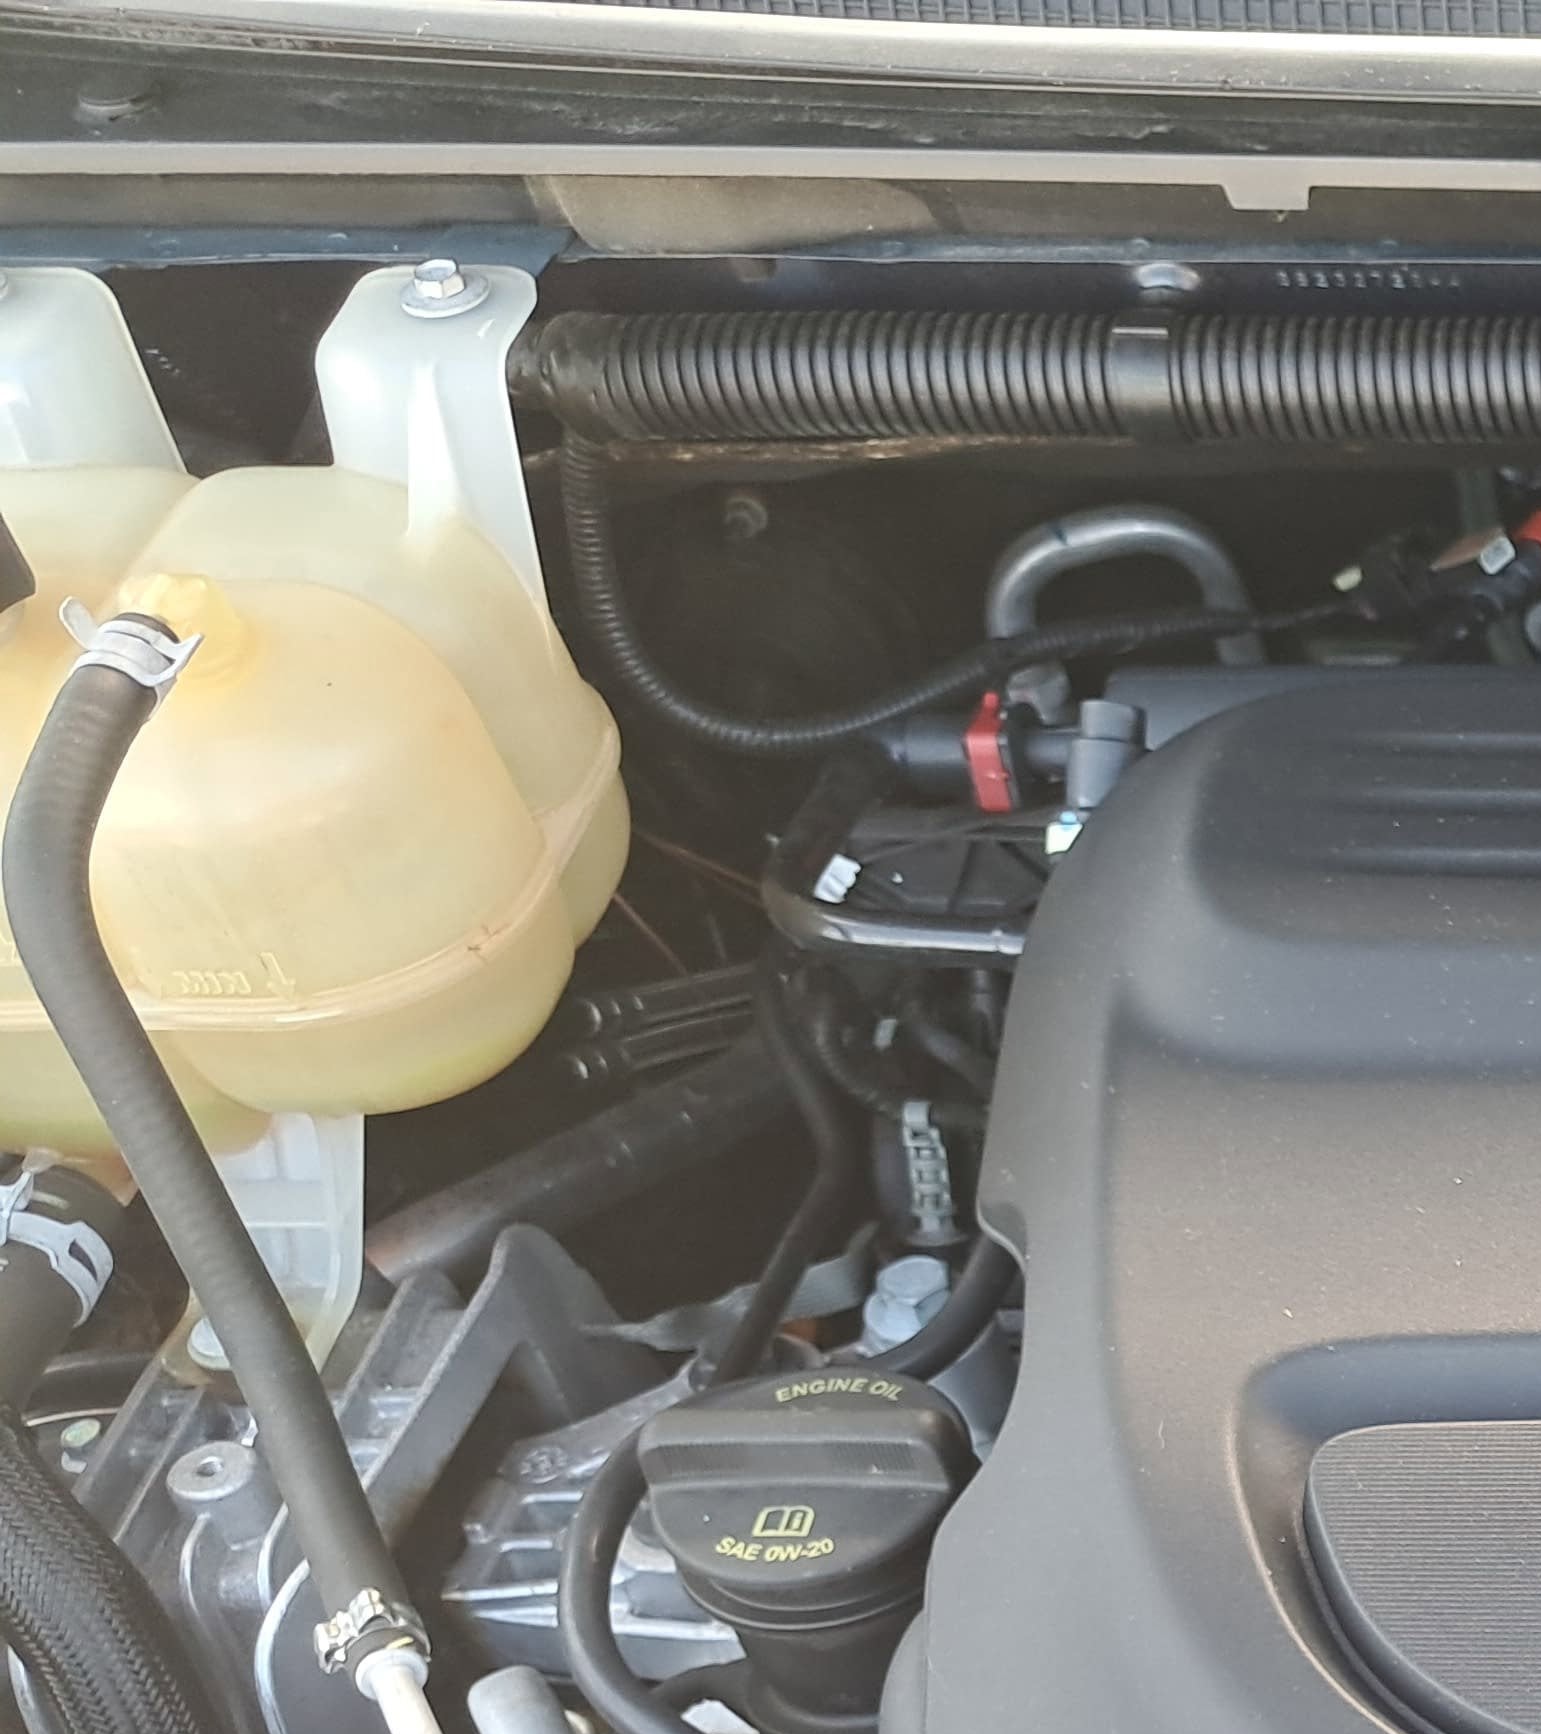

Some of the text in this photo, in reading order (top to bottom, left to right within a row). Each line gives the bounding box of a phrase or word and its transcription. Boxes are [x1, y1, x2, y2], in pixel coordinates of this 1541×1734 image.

[774, 1377, 903, 1403] ENGINE OIL
[714, 1536, 834, 1562] SAE 0W-20
